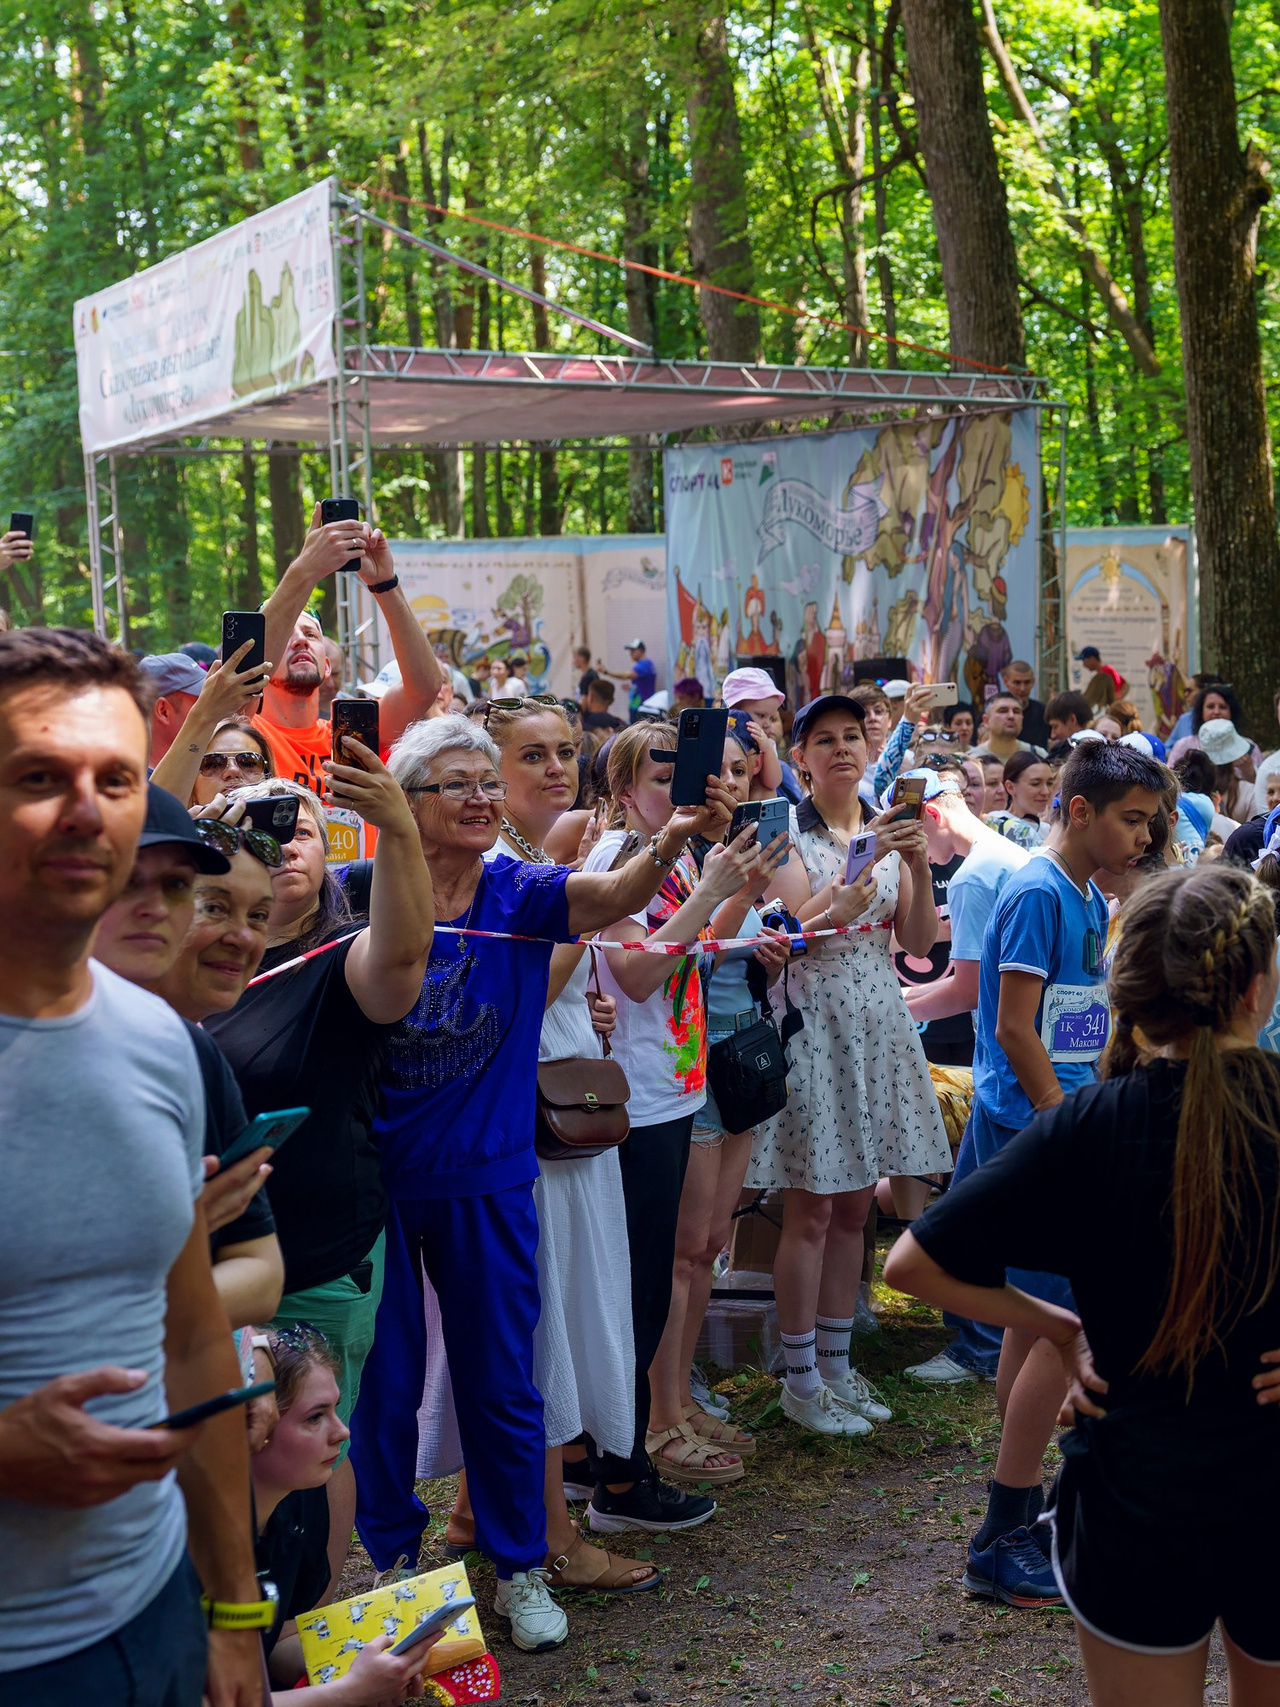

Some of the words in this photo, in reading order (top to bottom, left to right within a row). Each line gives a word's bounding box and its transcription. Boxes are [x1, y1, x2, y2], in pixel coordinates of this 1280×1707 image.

[777, 488, 863, 551] Лукоморье
[1082, 1013, 1105, 1036] 341
[1069, 1037, 1099, 1048] Максим
